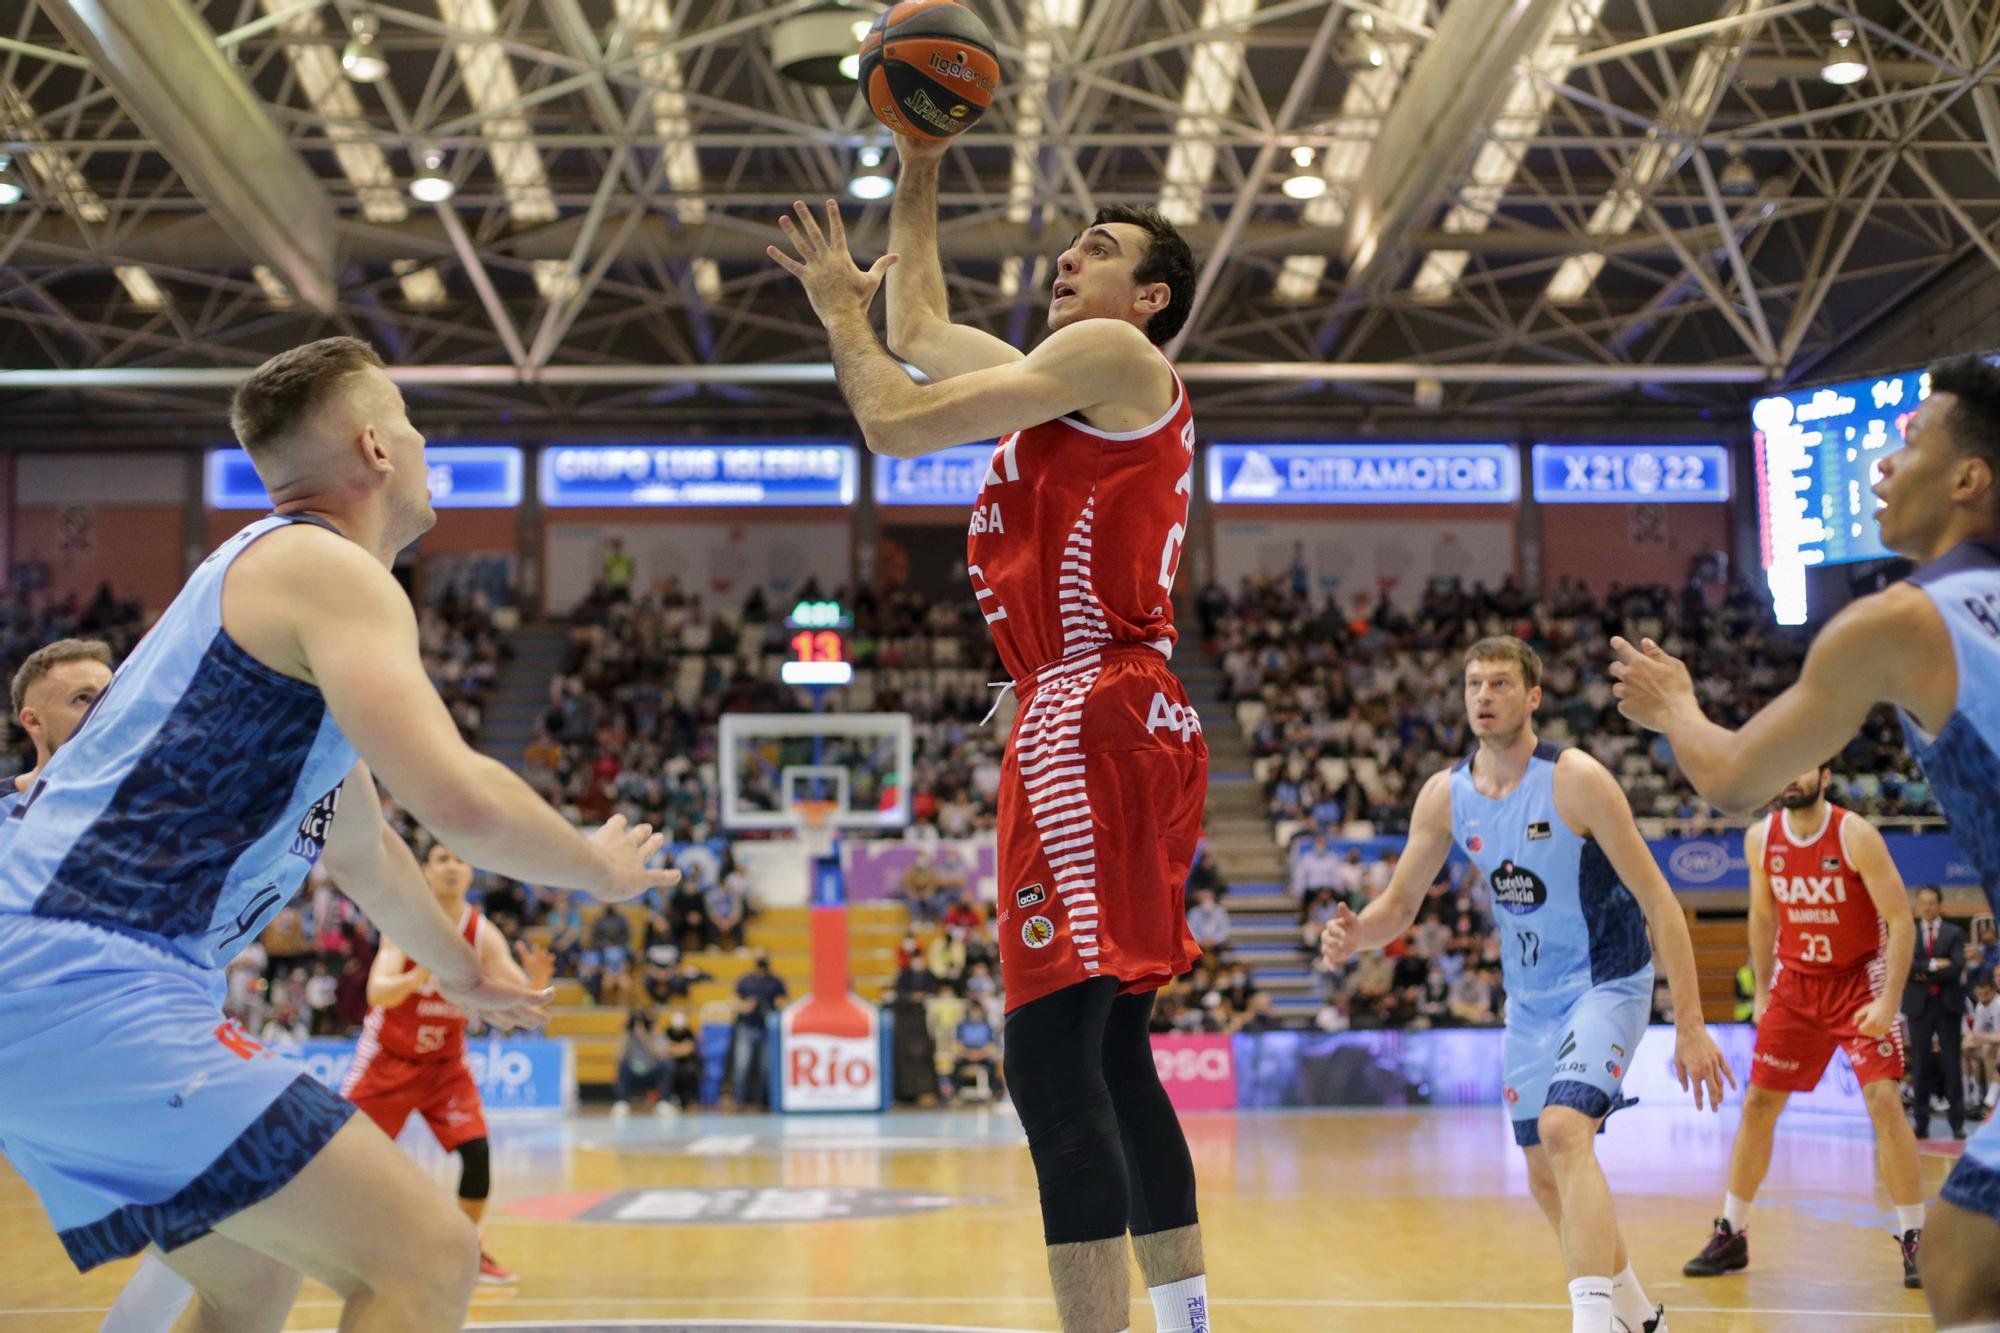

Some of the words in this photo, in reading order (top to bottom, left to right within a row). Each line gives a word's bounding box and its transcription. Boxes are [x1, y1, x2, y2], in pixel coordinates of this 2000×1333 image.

[1288, 457, 1498, 491] DITRAMOTOR
[1564, 455, 1625, 490] X21
[1663, 455, 1706, 491] 22
[791, 630, 842, 662] 13
[1019, 892, 1038, 905] acb
[1769, 875, 1847, 904] BAXI
[1799, 931, 1833, 963] 33
